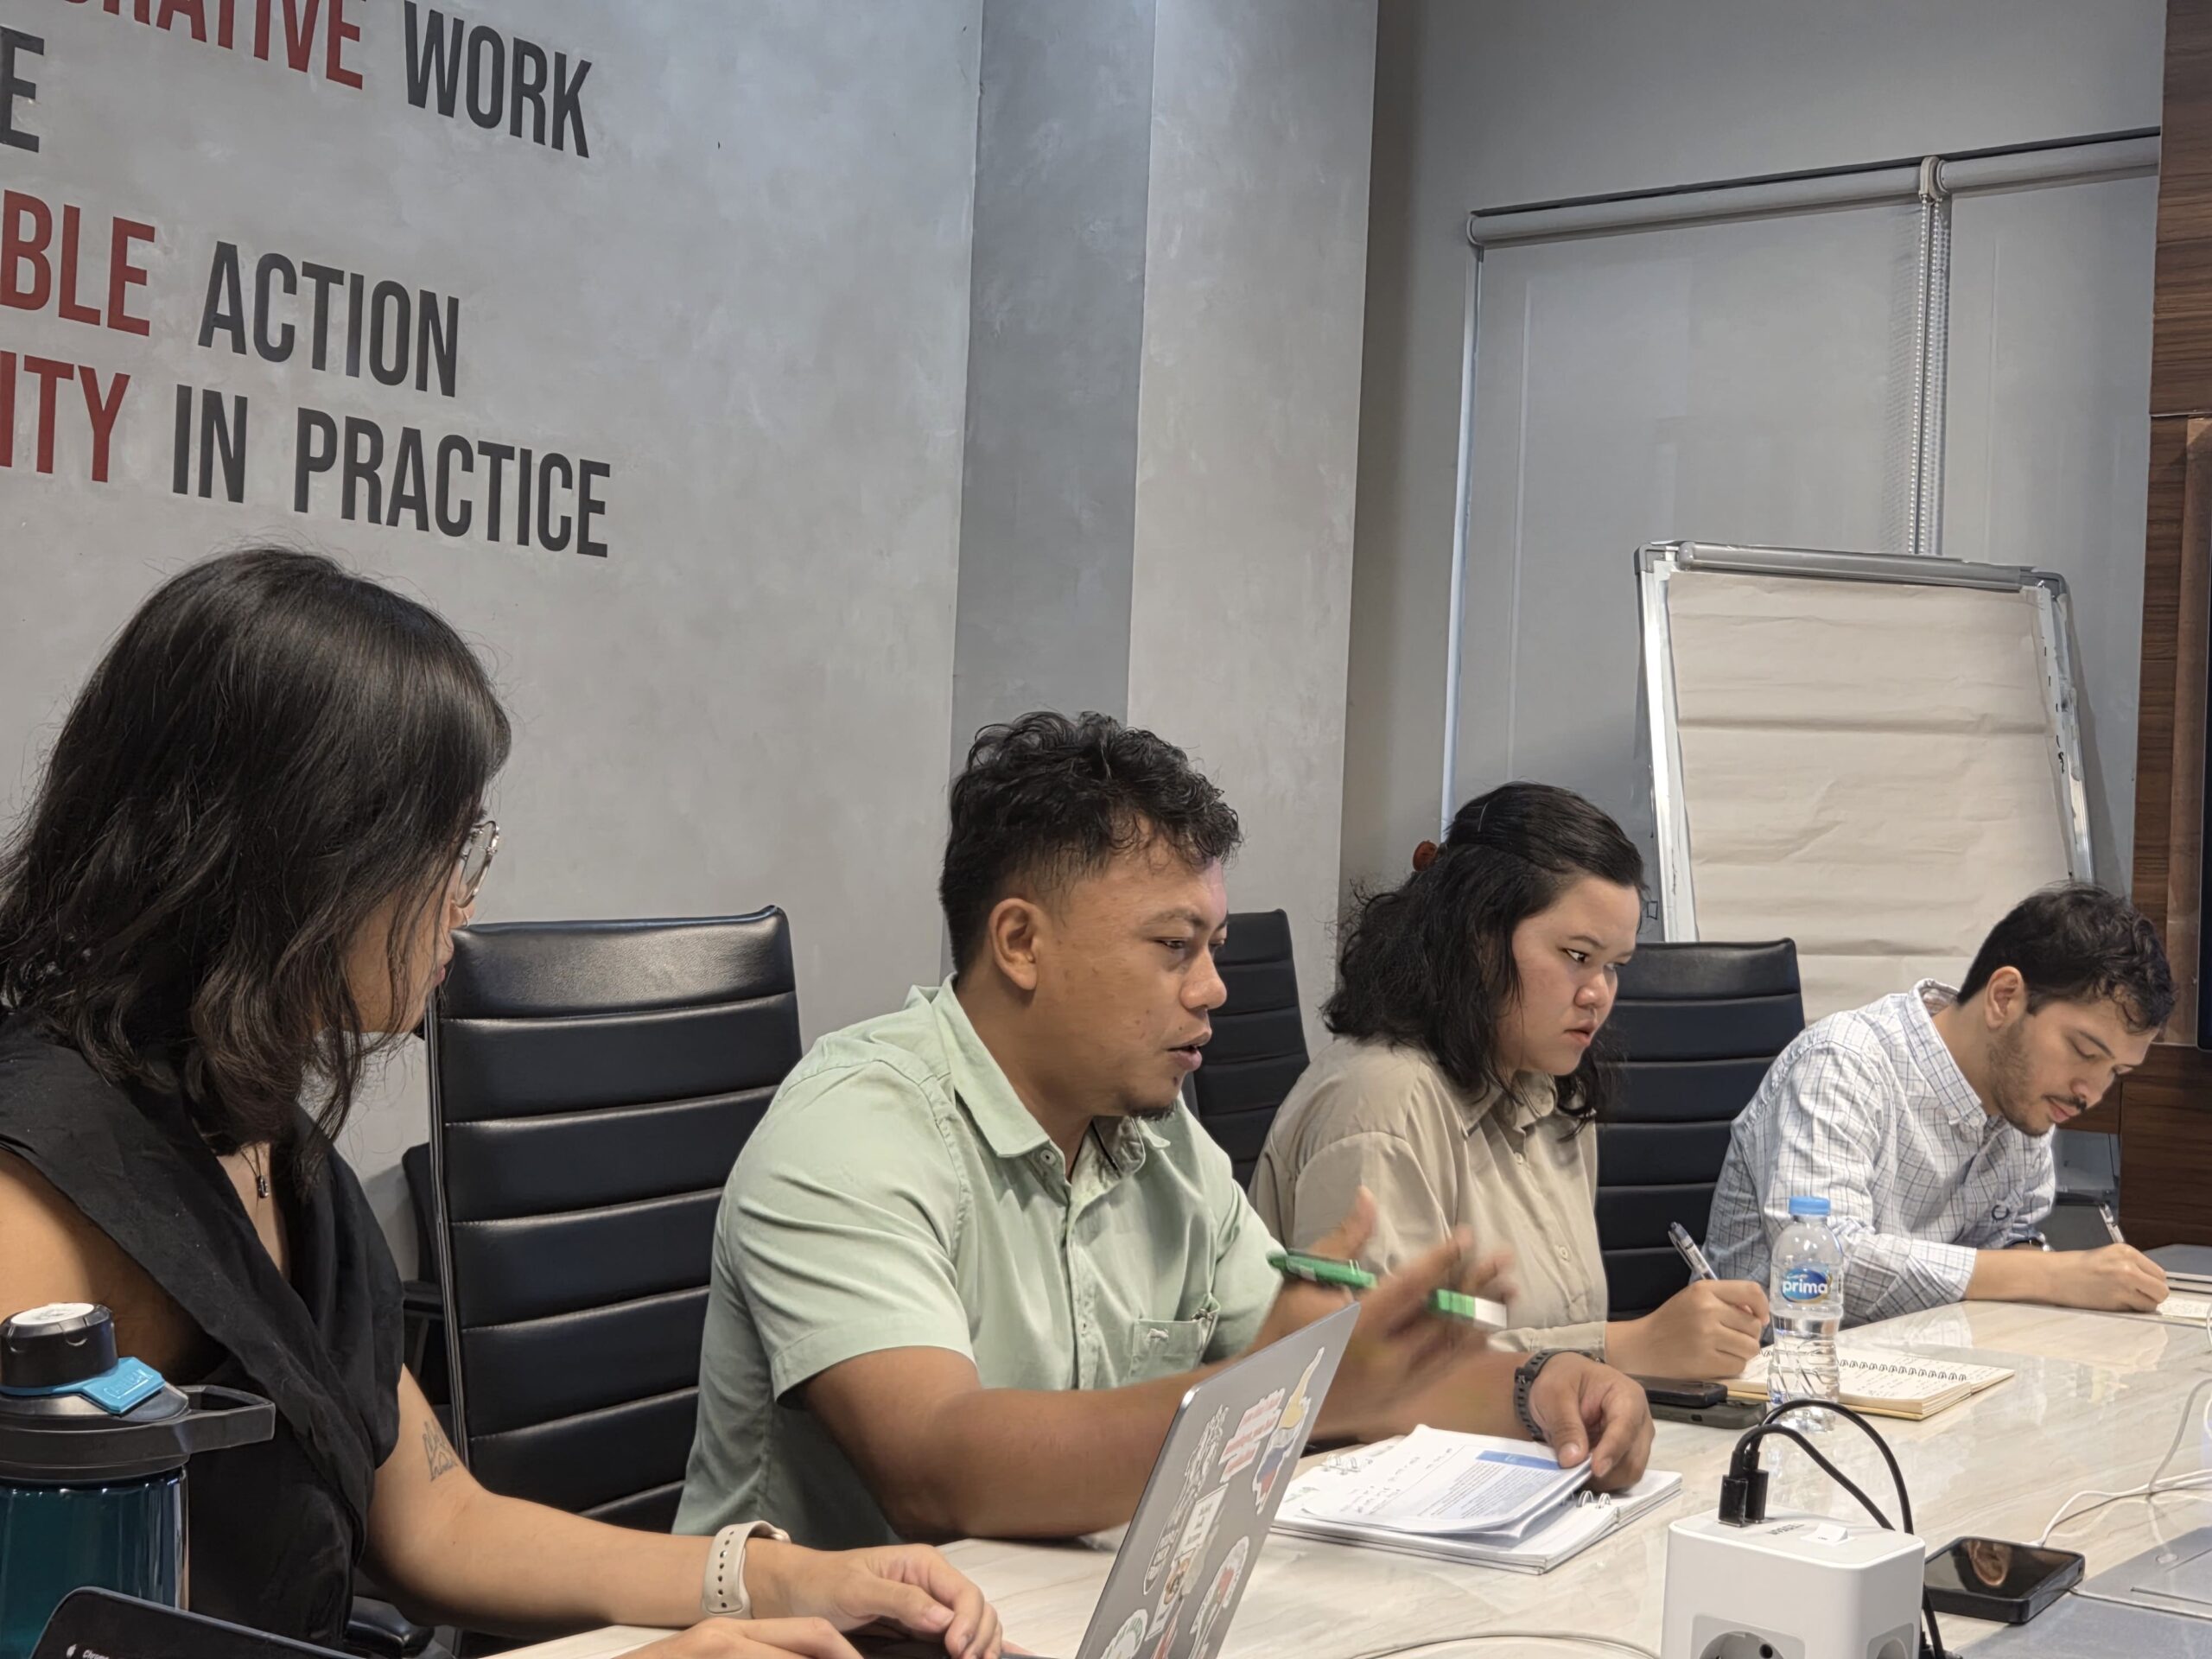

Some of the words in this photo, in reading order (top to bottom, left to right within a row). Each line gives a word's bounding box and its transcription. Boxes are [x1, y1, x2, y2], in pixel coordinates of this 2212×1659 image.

[404, 0, 592, 158] WORK
[0, 189, 156, 337] BLE
[198, 241, 460, 397] ACTION
[173, 384, 248, 504] IN
[294, 406, 610, 558] PRACTICE
[1783, 1278, 1827, 1294] prima
